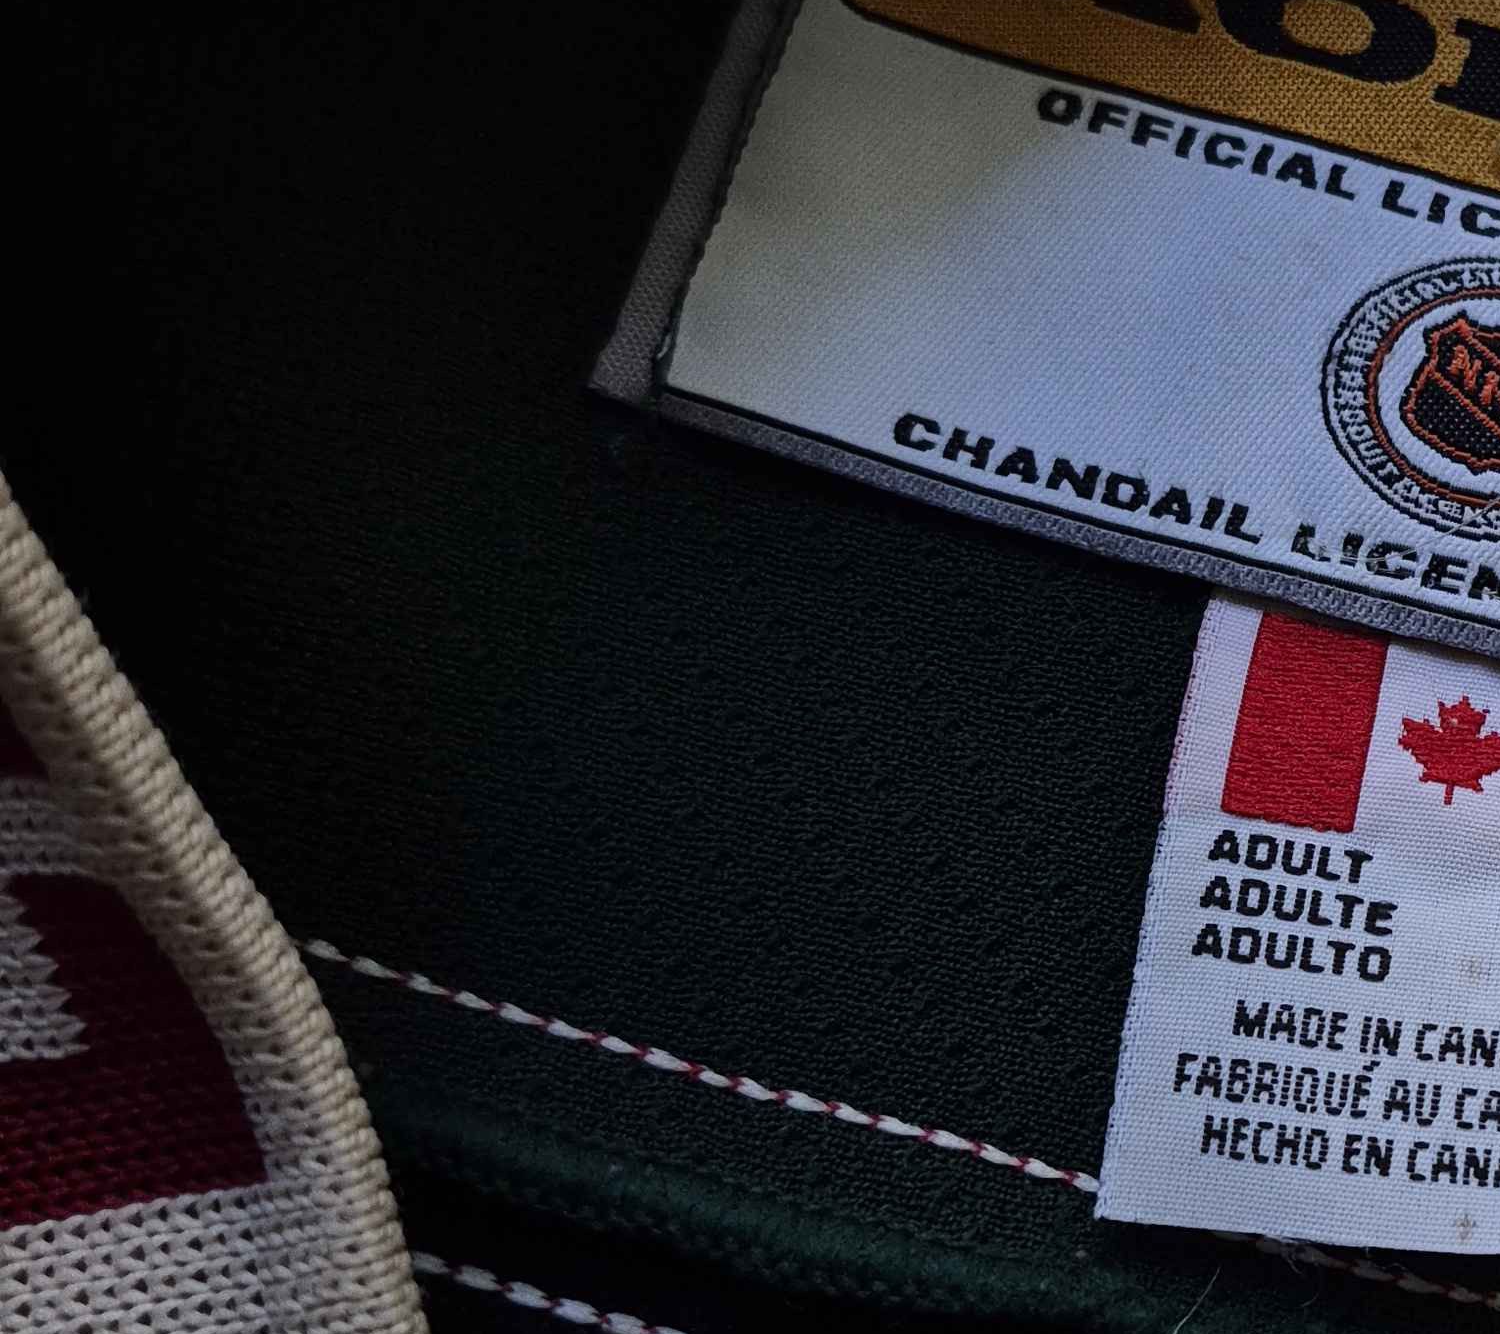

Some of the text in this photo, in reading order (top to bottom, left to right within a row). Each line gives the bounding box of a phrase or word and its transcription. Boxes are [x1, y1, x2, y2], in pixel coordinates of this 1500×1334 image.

[1037, 88, 1357, 201] OFFICIAL
[893, 412, 1264, 545] CHANDAIL
[1208, 830, 1373, 883] ADULT
[1200, 876, 1398, 936] ADULTE
[1192, 923, 1393, 983] ADULTO
[1231, 999, 1349, 1051] MADE
[1359, 1016, 1403, 1057] IN
[1172, 1052, 1382, 1120] FABRIQUÉ
[1382, 1079, 1441, 1126] AU
[1200, 1115, 1329, 1171] HECHO
[1342, 1133, 1394, 1178] EN
